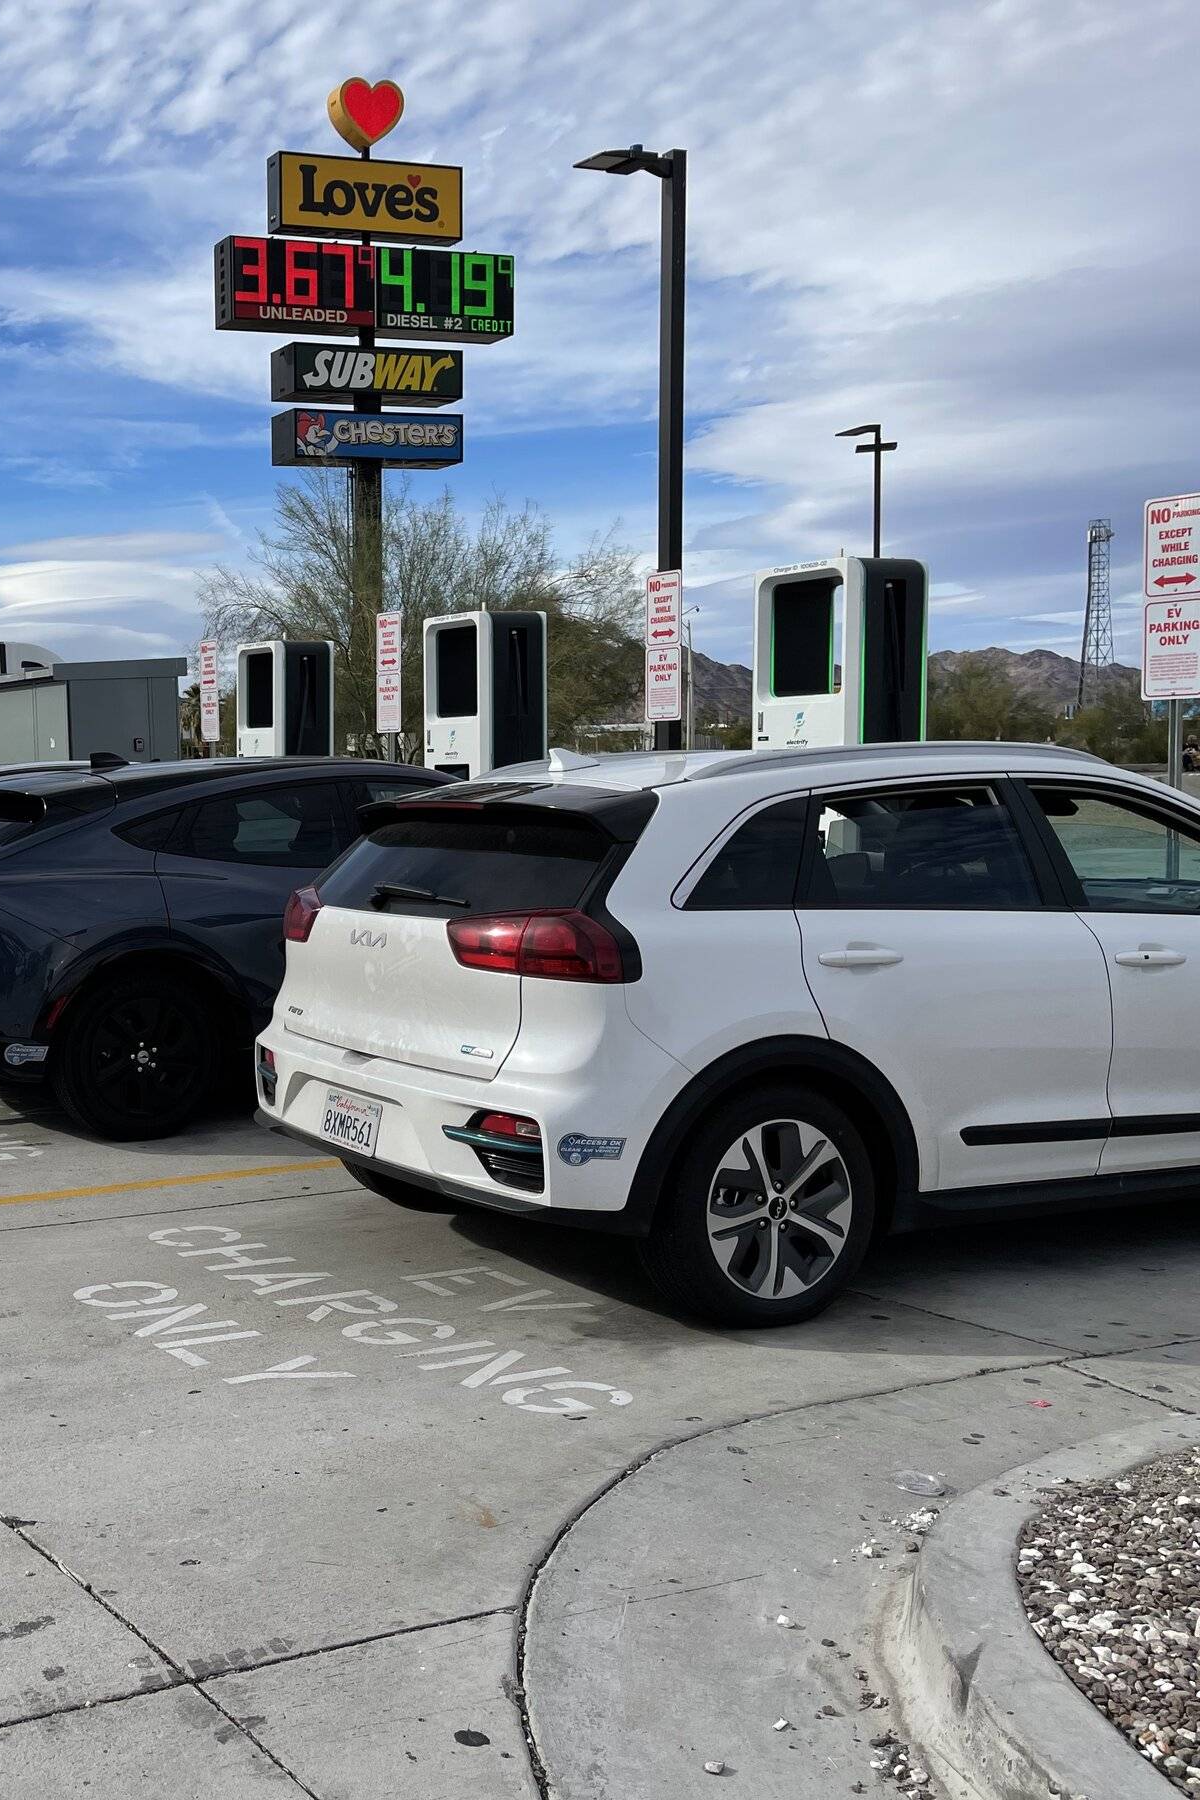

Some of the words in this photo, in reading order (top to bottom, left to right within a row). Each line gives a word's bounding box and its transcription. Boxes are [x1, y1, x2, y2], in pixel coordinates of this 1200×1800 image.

[259, 305, 348, 324] UNLEADED
[386, 313, 438, 330] DIESEL
[443, 317, 464, 331] #2
[470, 318, 513, 334] CREDIT
[302, 350, 456, 391] SUBWAY
[1150, 507, 1172, 525] NO
[1158, 527, 1192, 540] EXCEPT
[1161, 541, 1190, 554] WHILE
[1152, 554, 1199, 568] CHARGING
[649, 580, 661, 593] NO
[653, 594, 673, 604] EXCEPT
[655, 605, 671, 614] WHILE
[1167, 607, 1182, 619] EV
[650, 614, 676, 625] CHARGING
[1149, 620, 1200, 634] PARKING
[1159, 634, 1189, 646] ONLY
[658, 654, 668, 662] EV
[649, 662, 678, 672] PARKING
[654, 673, 672, 682] ONLY
[350, 928, 388, 949] KIA
[323, 1109, 373, 1148] 8XMR561
[400, 1266, 595, 1312] EV
[148, 1225, 634, 1414] CHARGING
[73, 1280, 357, 1384] ONLY
